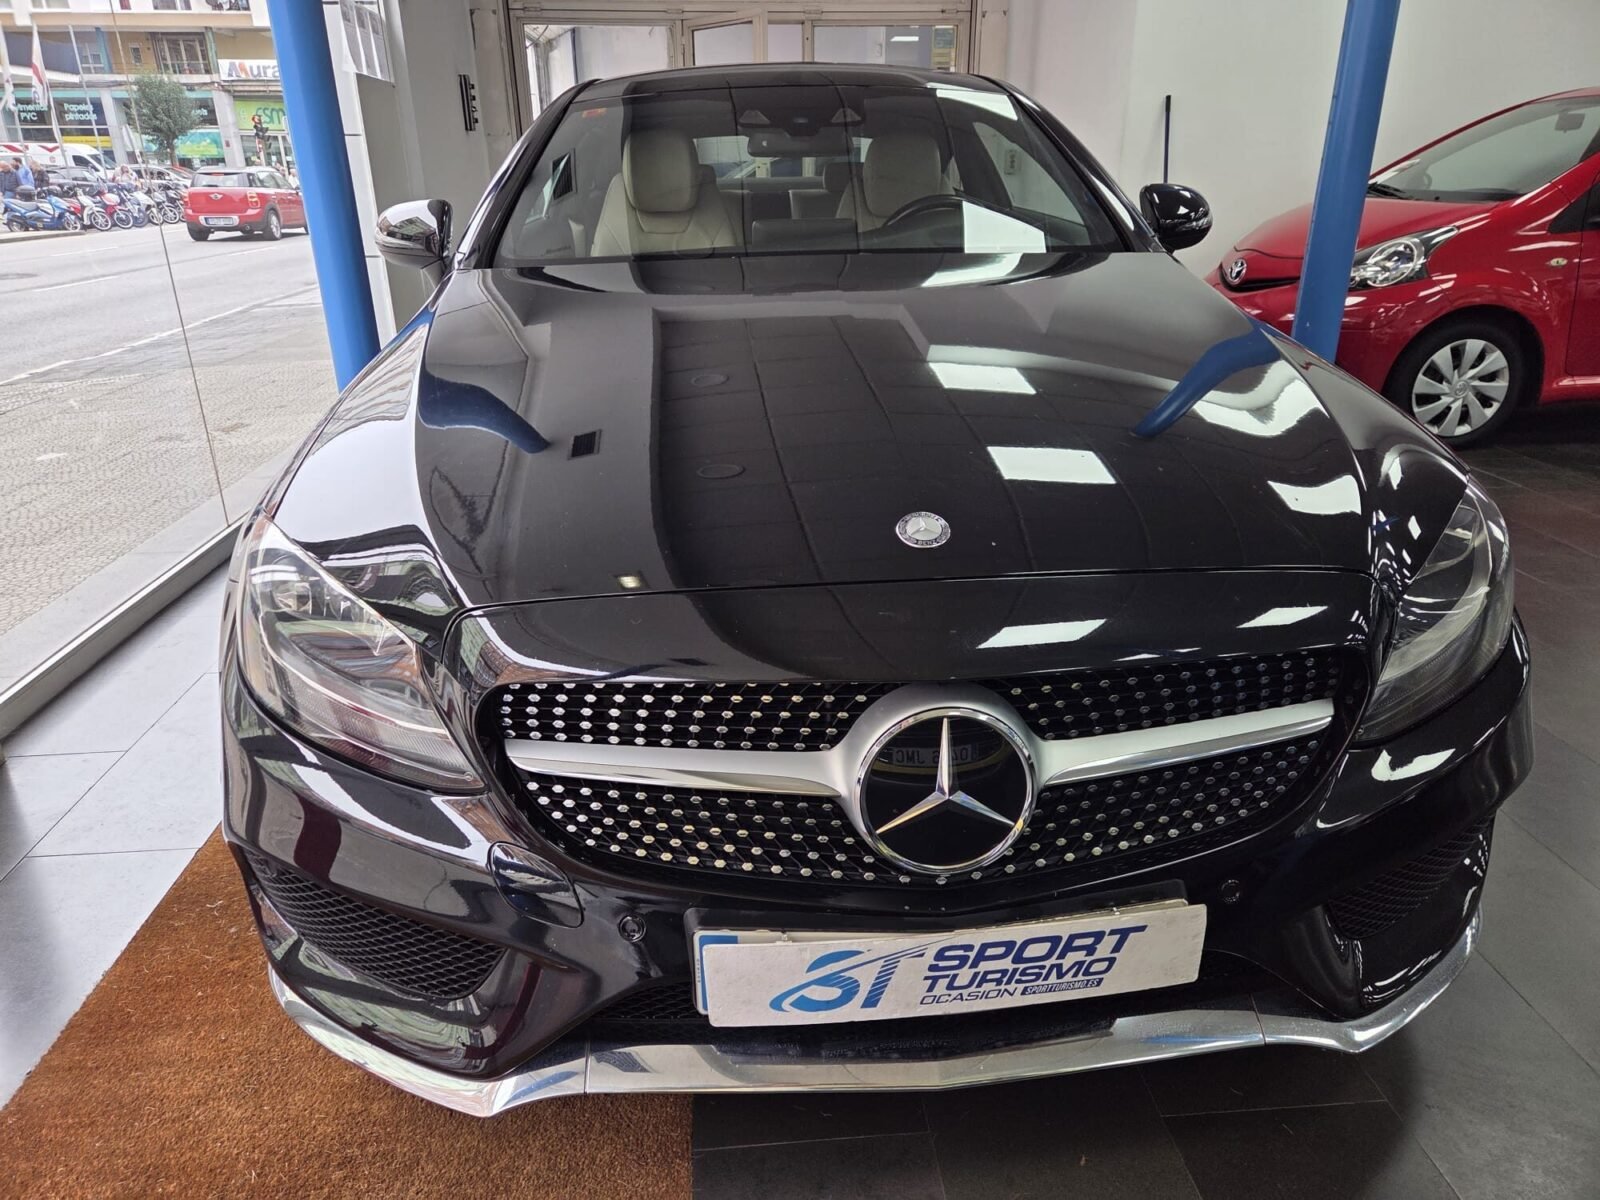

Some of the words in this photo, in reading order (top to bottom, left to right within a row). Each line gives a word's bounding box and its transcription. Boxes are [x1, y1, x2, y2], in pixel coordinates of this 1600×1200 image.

[20, 112, 38, 120] PVC
[927, 924, 1148, 973] SPORT
[922, 956, 1117, 993] TURISMO
[919, 986, 1018, 1005] OCASION
[1024, 978, 1101, 995] SPORTTURISMO.ES
